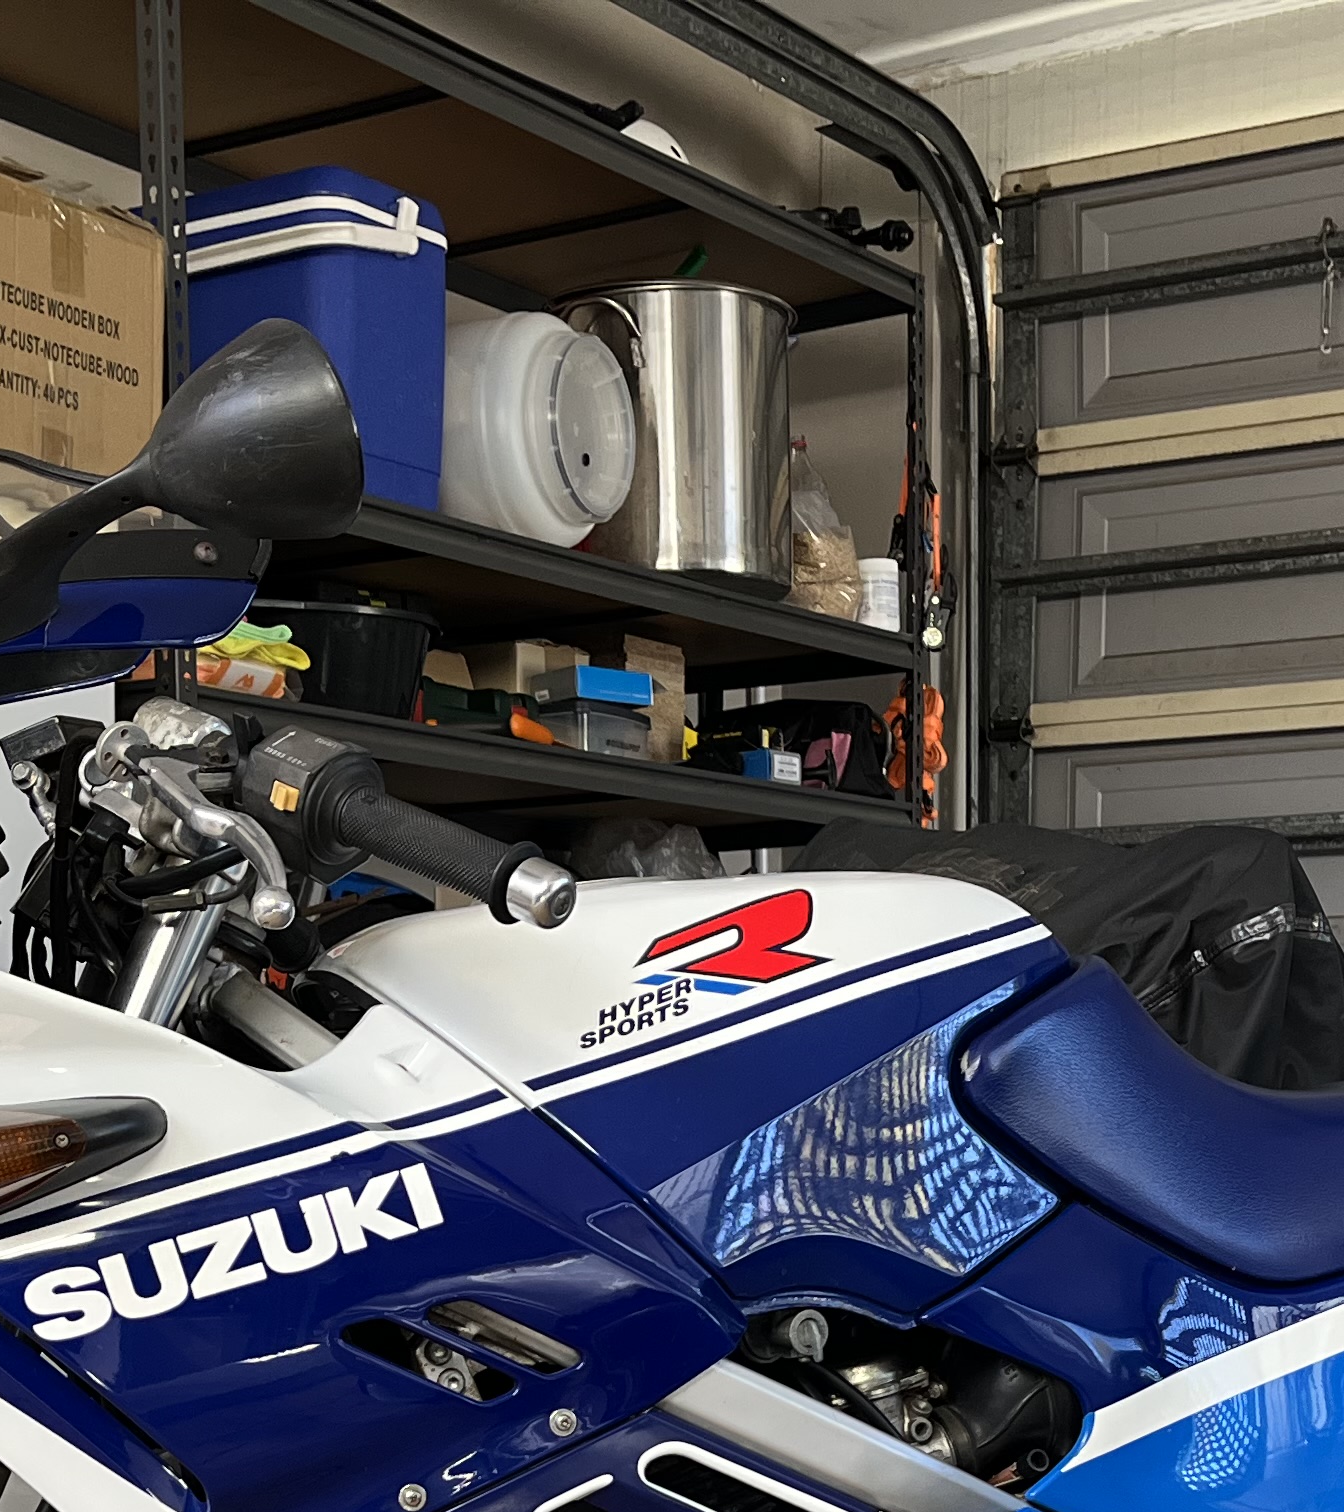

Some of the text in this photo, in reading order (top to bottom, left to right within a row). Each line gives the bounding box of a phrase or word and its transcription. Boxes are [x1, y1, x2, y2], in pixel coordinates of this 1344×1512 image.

[46, 300, 96, 332] WOODEN
[97, 314, 121, 340] BOX
[43, 383, 56, 404] 40
[57, 386, 79, 411] PCS
[579, 997, 690, 1050] SPORTS
[598, 977, 693, 1027] HYPER
[23, 1162, 445, 1342] SUZUKI
